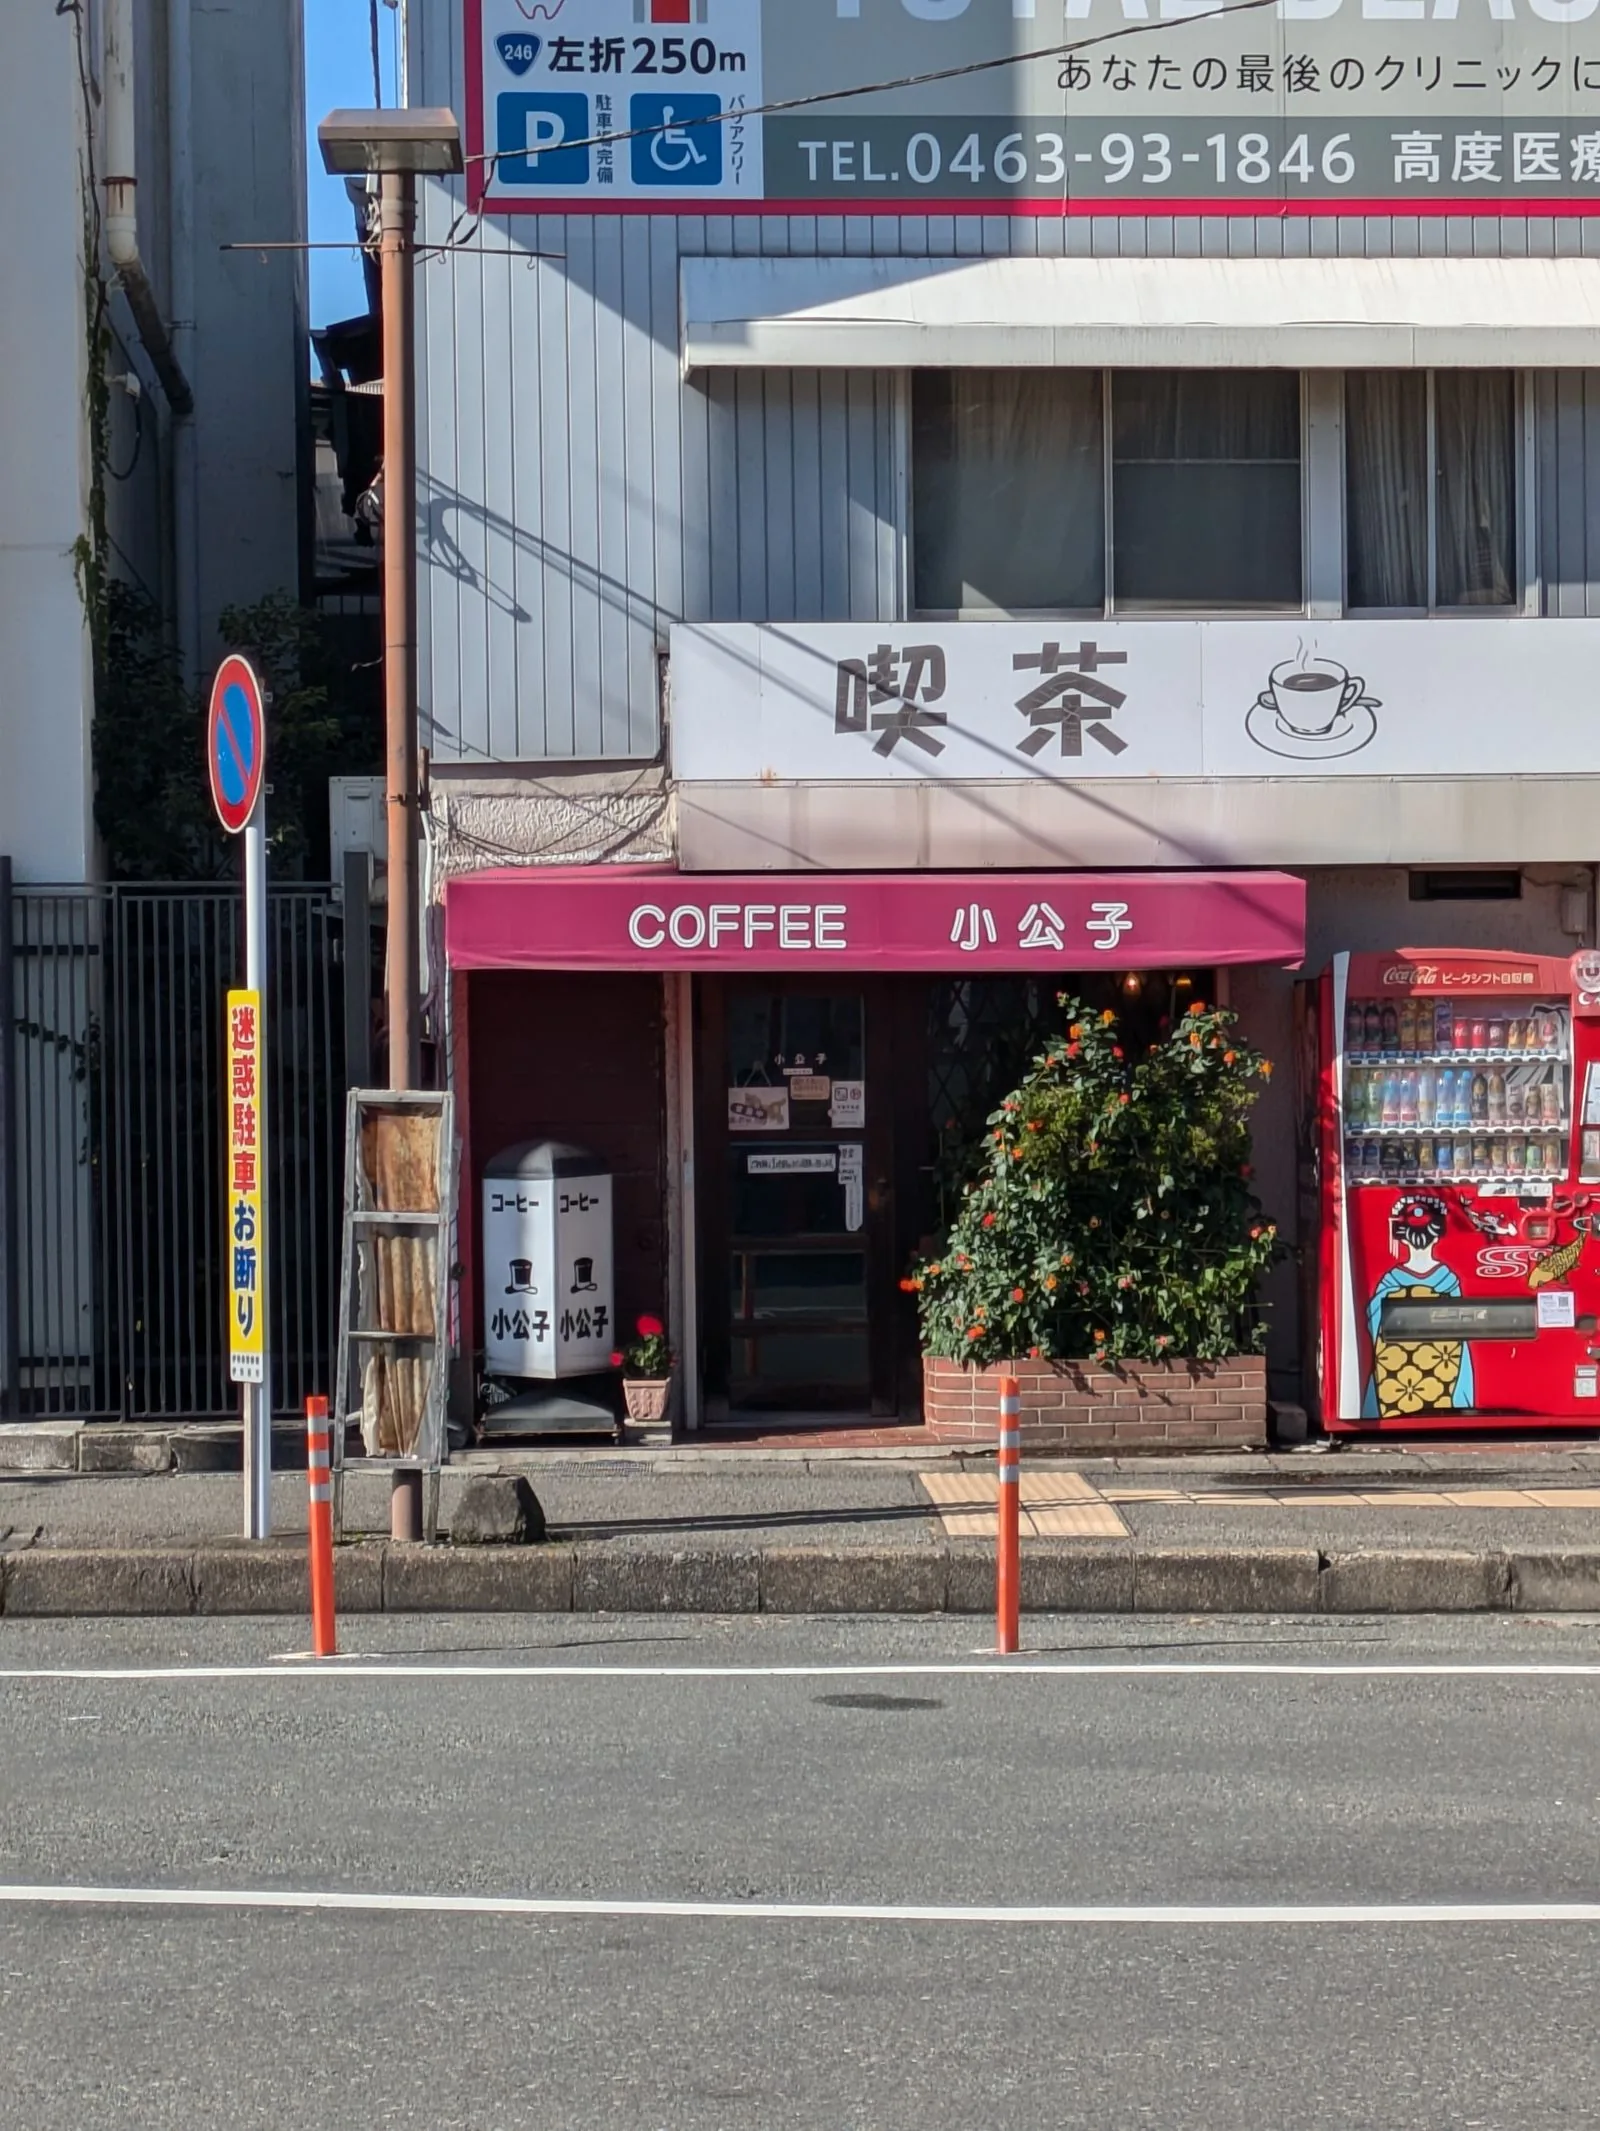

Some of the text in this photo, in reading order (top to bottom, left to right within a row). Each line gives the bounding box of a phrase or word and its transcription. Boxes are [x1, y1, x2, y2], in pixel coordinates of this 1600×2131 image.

[504, 44, 533, 61] 246
[547, 36, 746, 75] 左折250m
[1057, 54, 1600, 93] あなたの最後のクリニックに
[525, 110, 566, 168] P
[798, 132, 1356, 184] TEL.0463-93-1846
[835, 641, 1128, 758] 喫茶
[628, 904, 847, 950] COFFEE
[950, 902, 1133, 951] 小公子
[231, 1006, 256, 1338] 迷惑駐車お断り
[491, 1193, 539, 1213] コーヒー
[559, 1192, 600, 1213] コーヒー
[491, 1308, 550, 1342] 小公子
[560, 1305, 609, 1342] 小公子
